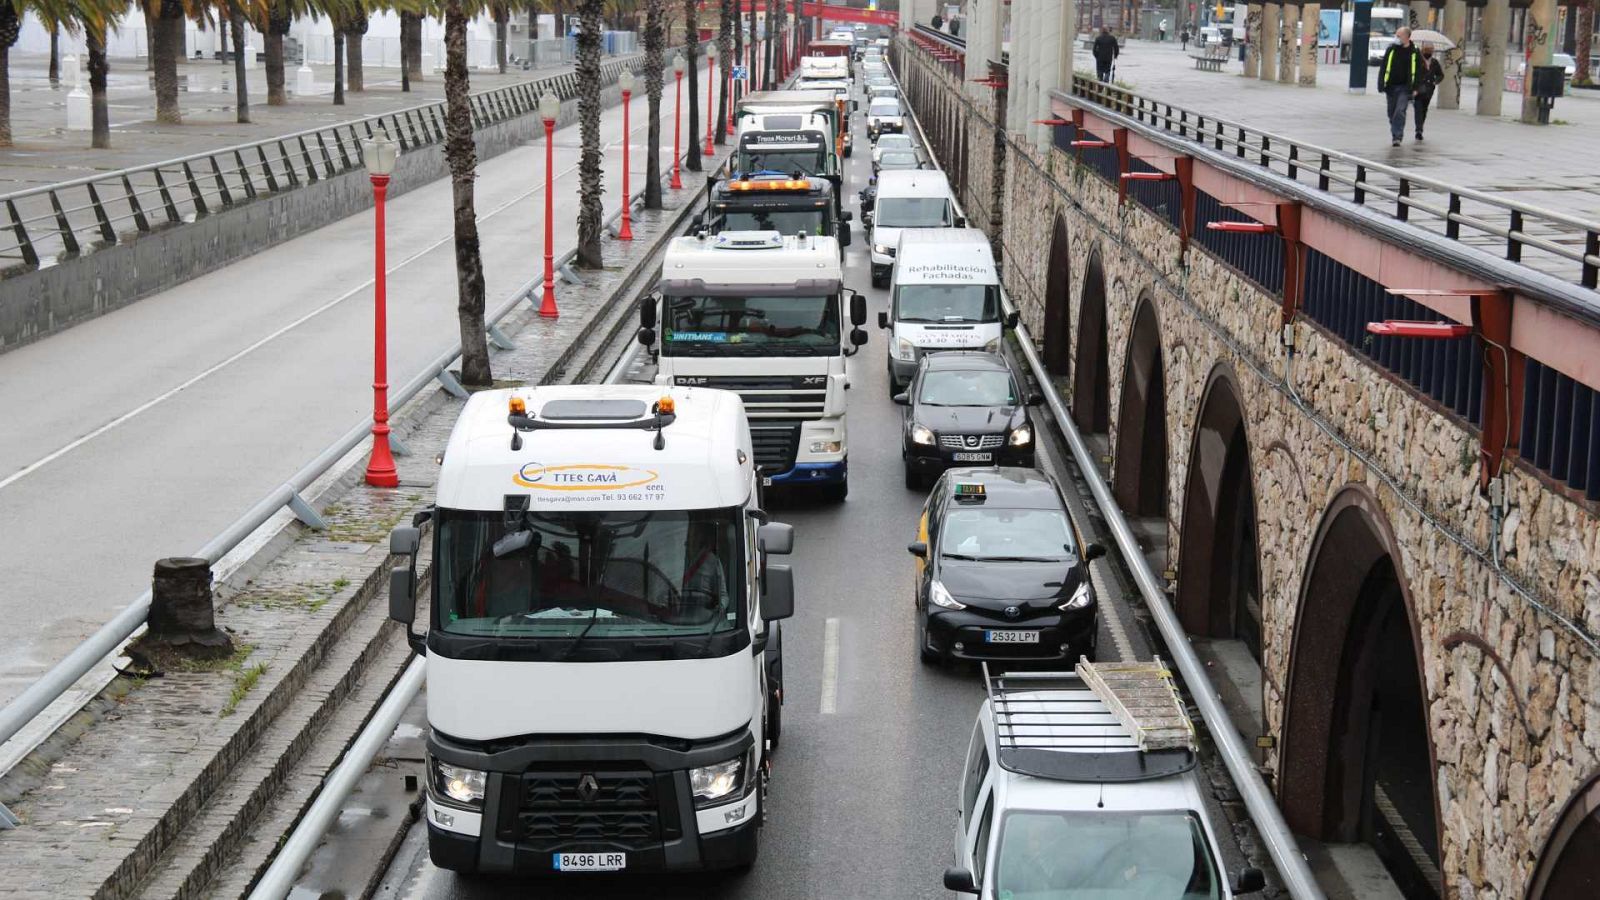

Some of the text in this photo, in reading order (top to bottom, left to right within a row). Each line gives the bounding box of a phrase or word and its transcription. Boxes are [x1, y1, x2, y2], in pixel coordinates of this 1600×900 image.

[908, 264, 987, 274] Rehabilitación
[923, 272, 974, 280] Fachadas
[673, 332, 714, 341] UNITRANS
[676, 377, 707, 385] DAF
[553, 473, 583, 482] TTES
[602, 493, 615, 501] Tel.
[617, 493, 627, 501] 93
[628, 493, 643, 501] 662
[645, 493, 655, 501] 17
[655, 493, 665, 501] 97
[992, 632, 1037, 642] 2532 LPY
[562, 855, 623, 867] 8496 LRR
